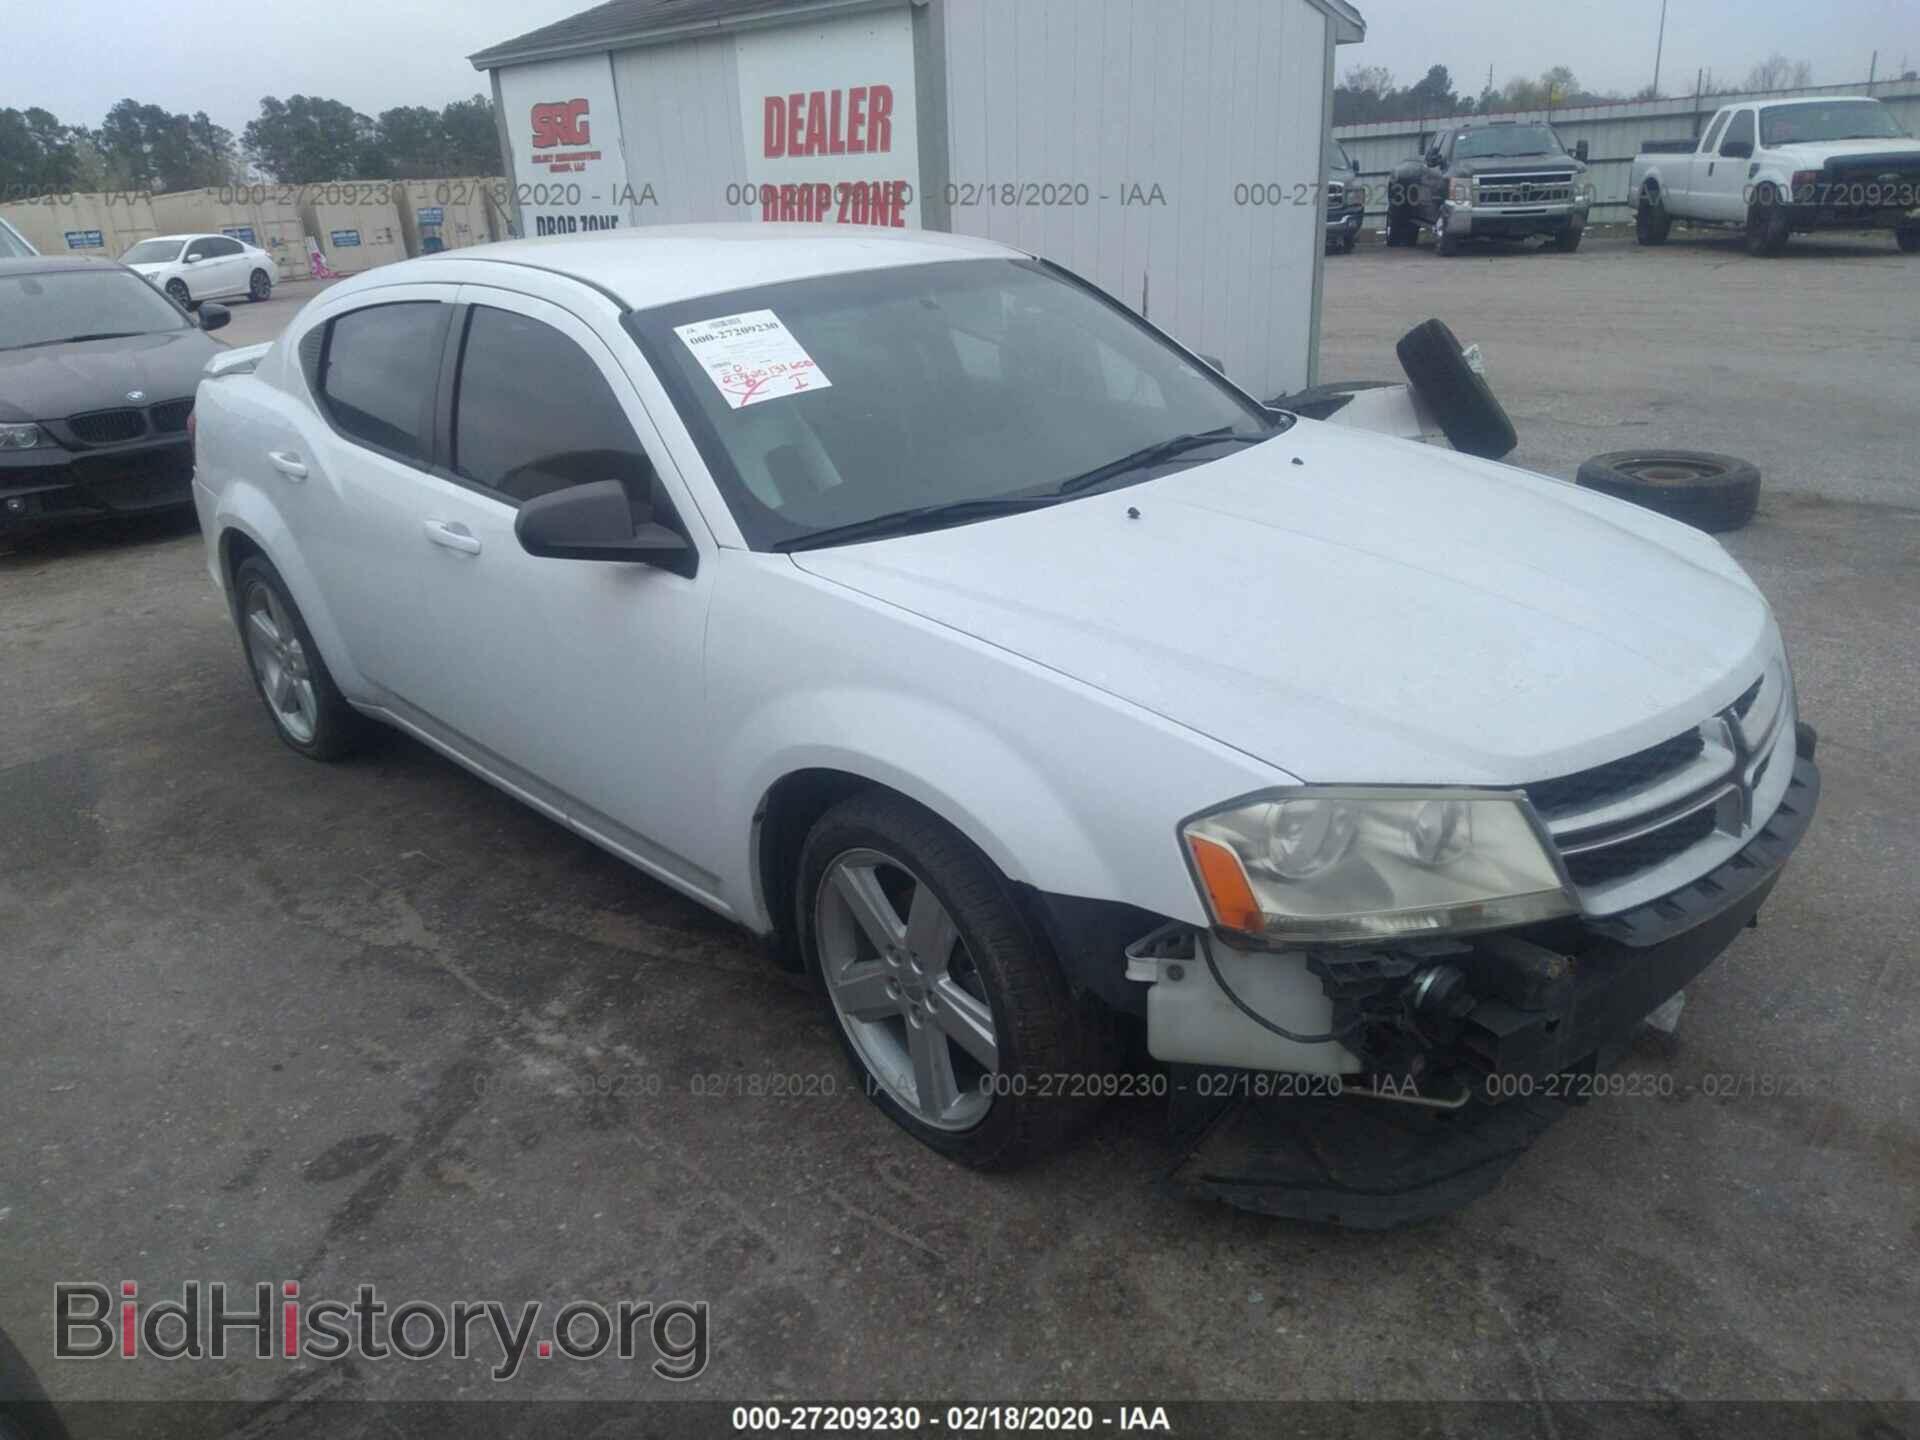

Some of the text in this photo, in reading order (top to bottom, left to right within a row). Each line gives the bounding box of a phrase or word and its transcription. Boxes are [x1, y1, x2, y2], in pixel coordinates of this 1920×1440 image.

[531, 98, 590, 148] SRG
[764, 85, 894, 159] DEALER
[762, 180, 907, 228] DROP ZONE
